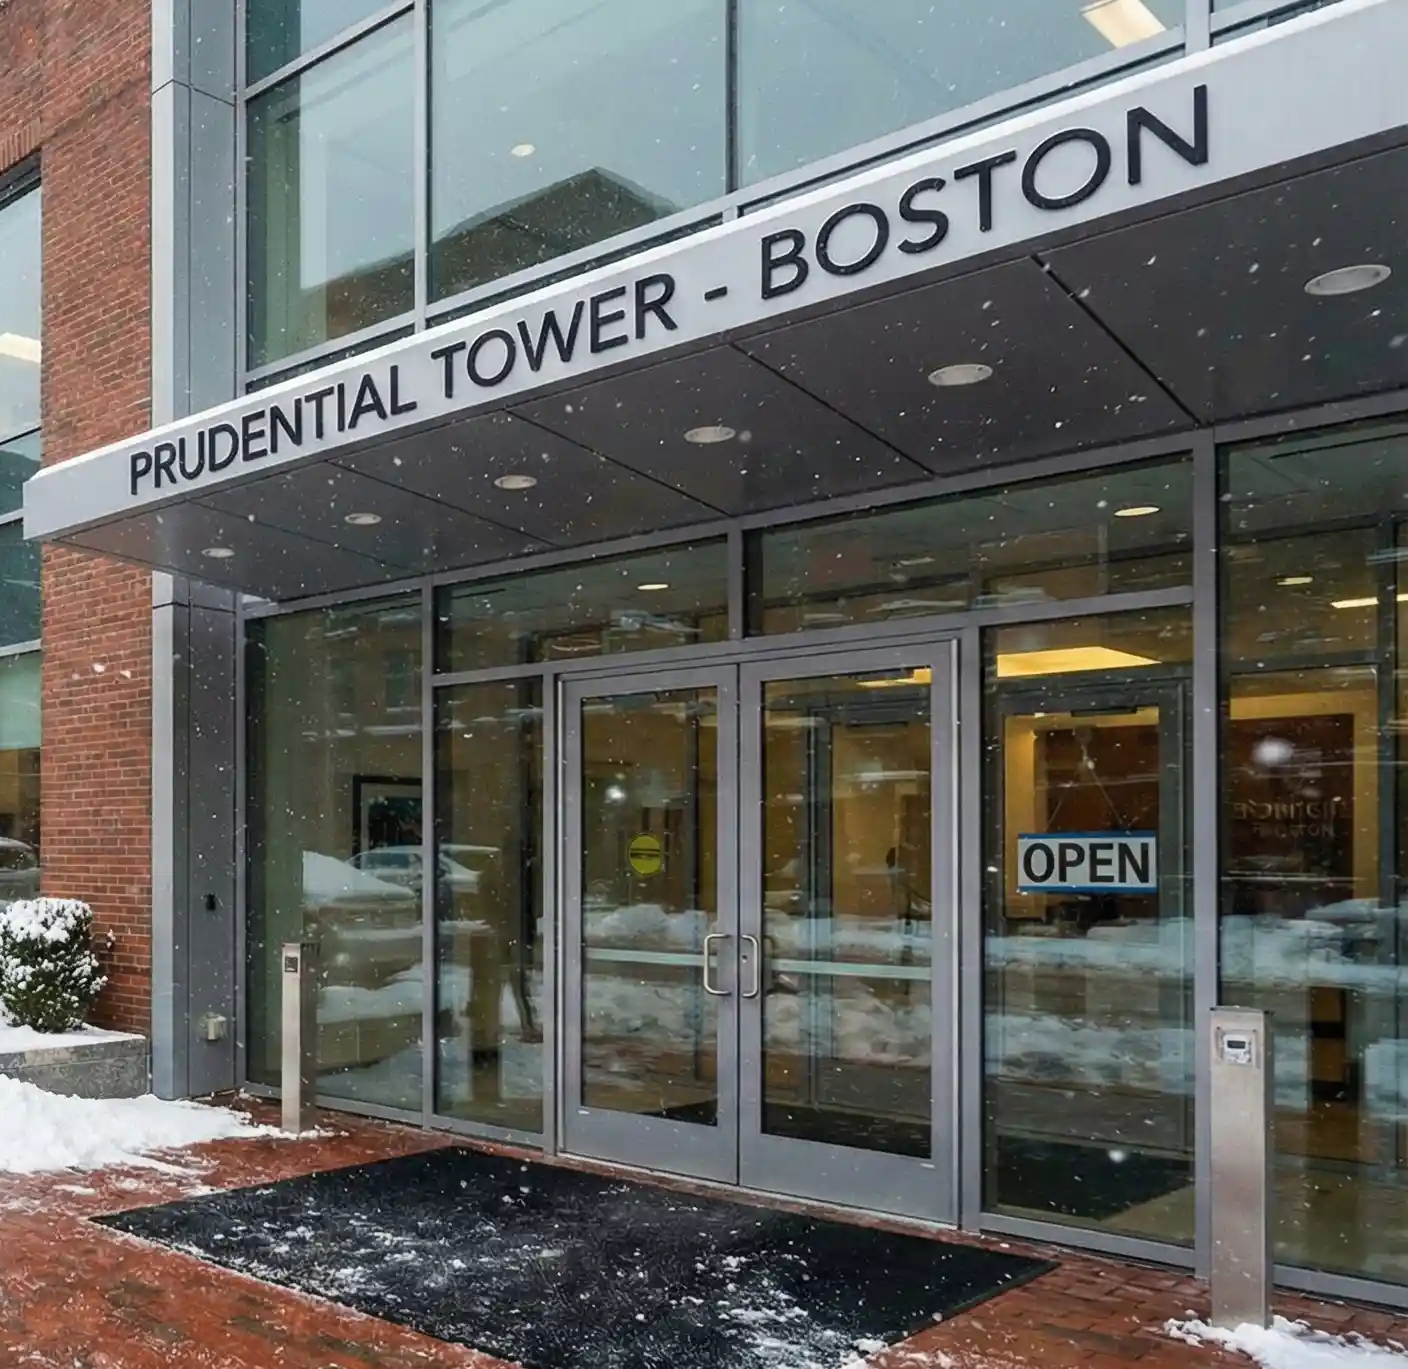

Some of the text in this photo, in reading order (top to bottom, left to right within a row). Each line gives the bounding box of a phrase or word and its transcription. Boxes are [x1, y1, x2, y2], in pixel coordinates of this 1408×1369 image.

[129, 365, 417, 495] PRUDENTIAL
[430, 273, 678, 399] TOWER
[760, 83, 1209, 301] BOSTON
[1023, 842, 1149, 883] OPEN
